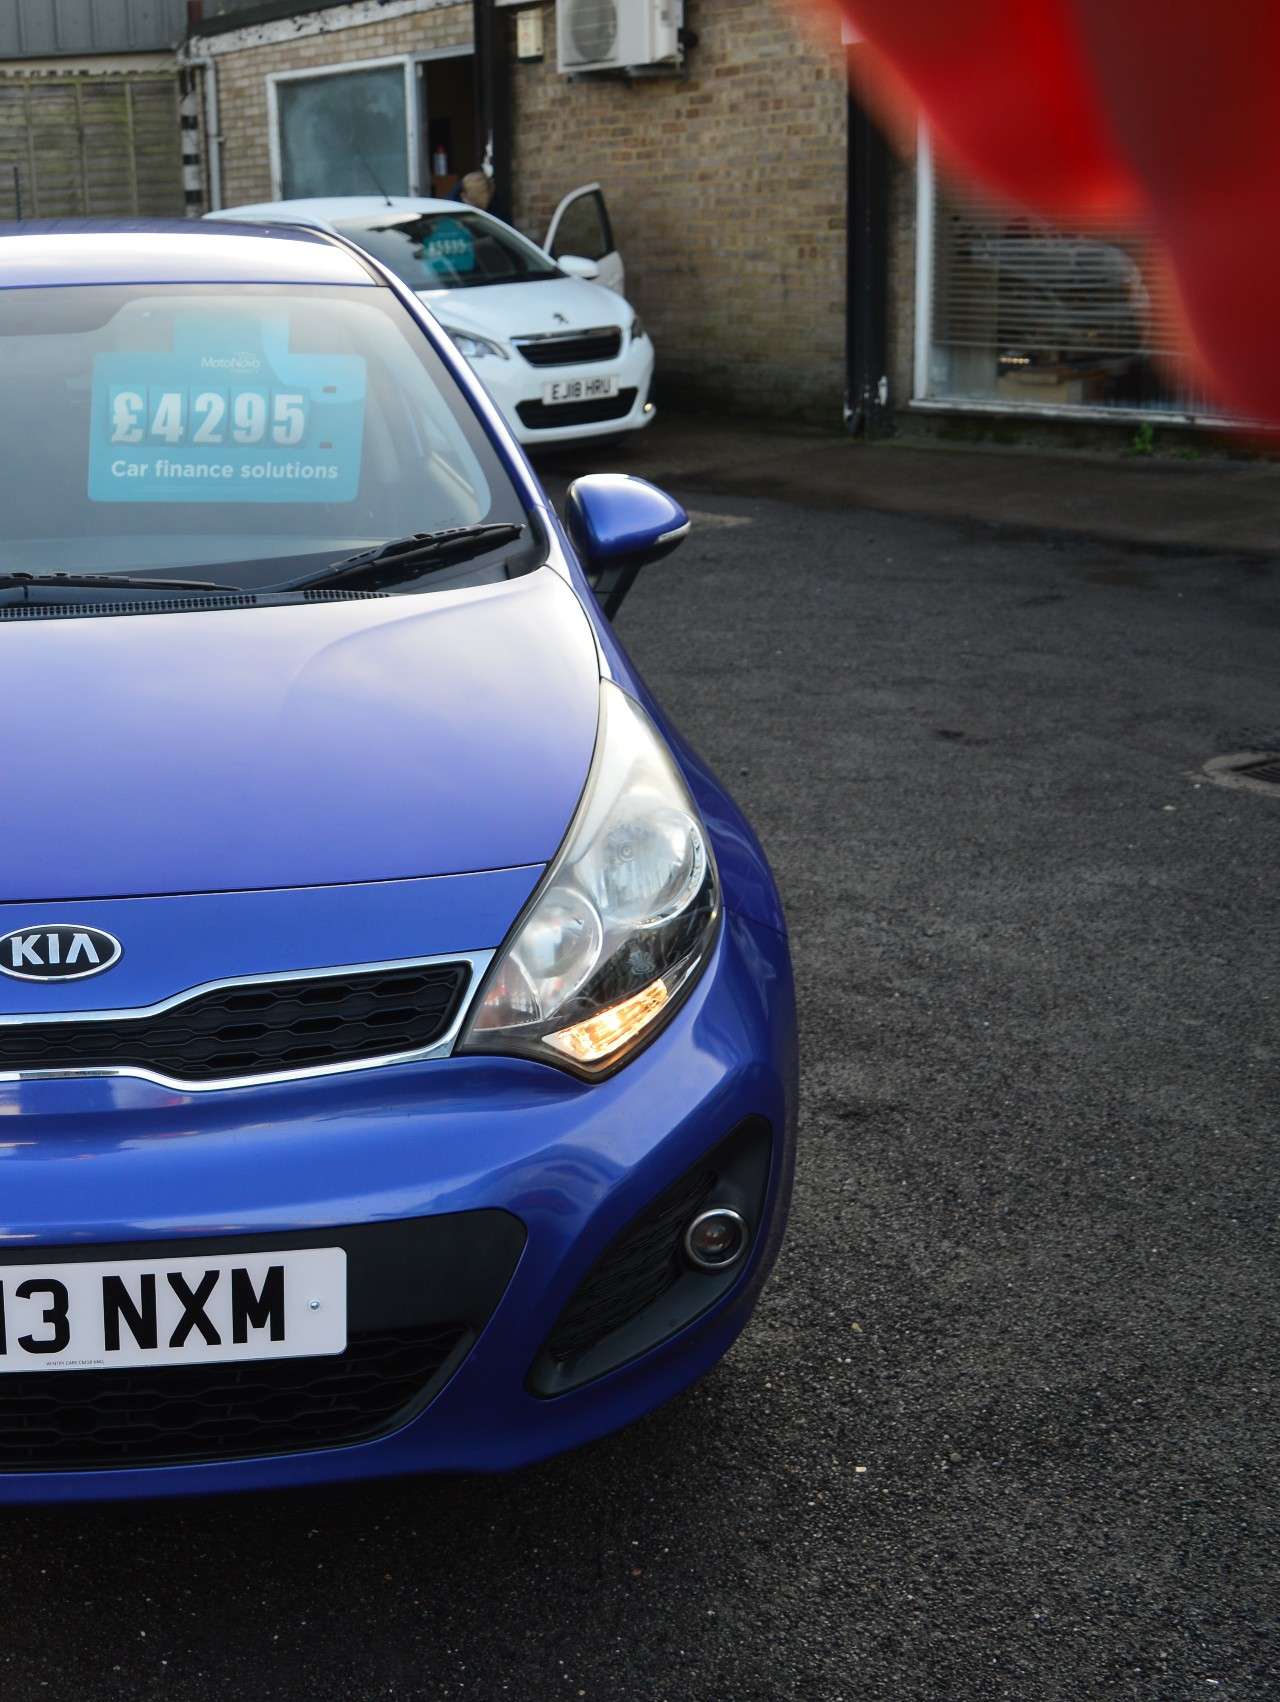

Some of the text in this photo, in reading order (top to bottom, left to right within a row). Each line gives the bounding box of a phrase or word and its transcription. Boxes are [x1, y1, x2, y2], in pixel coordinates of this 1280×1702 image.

[110, 391, 306, 445] £4295
[111, 459, 339, 480] Car finance solutions
[9, 932, 100, 967] KIA
[102, 1265, 287, 1352] NXM
